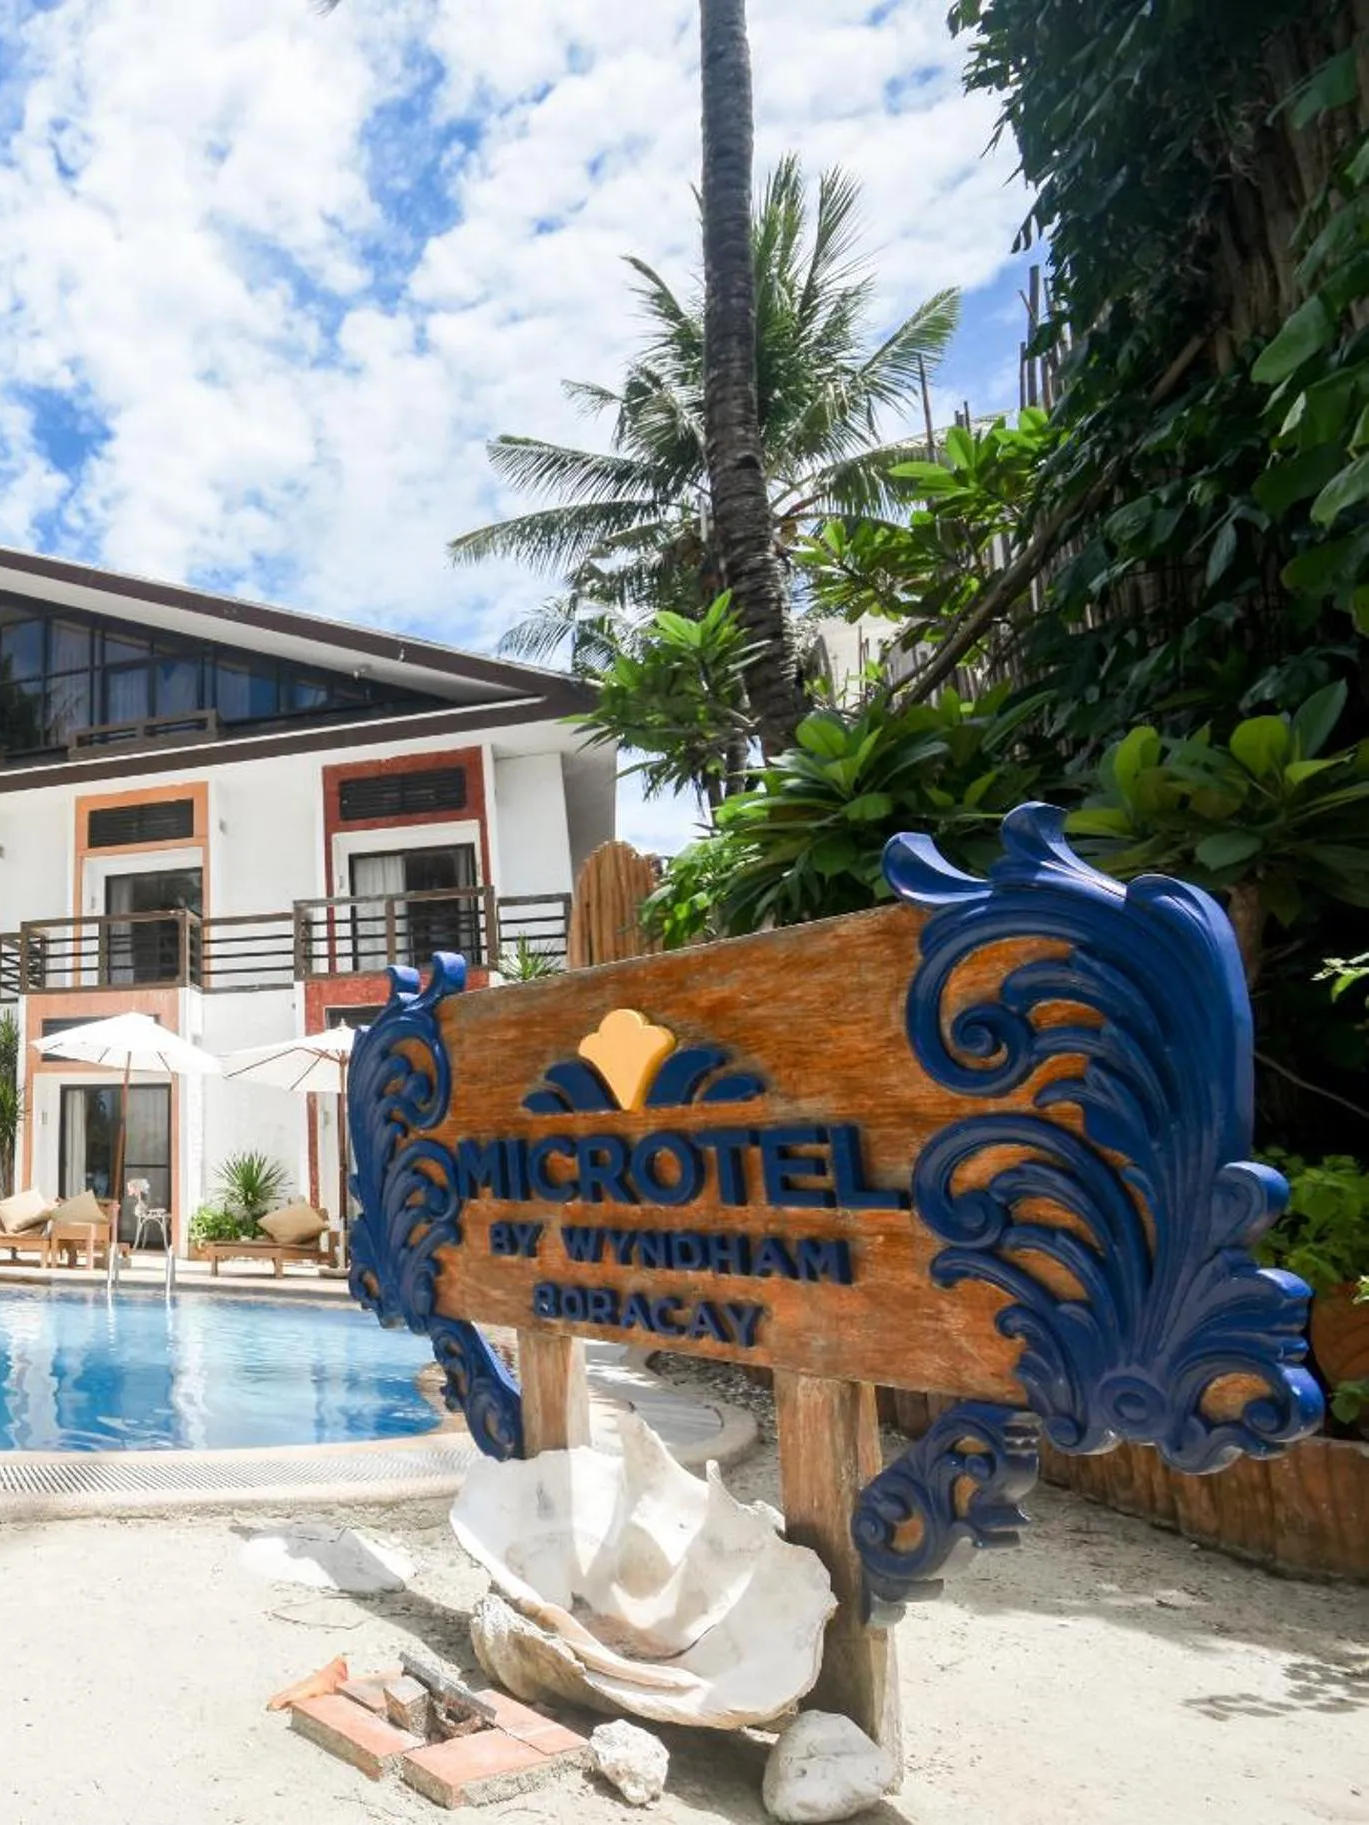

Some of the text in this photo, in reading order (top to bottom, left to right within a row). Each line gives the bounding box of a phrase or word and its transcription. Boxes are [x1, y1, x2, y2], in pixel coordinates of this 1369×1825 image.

[457, 1124, 911, 1209] MICROTEL
[489, 1220, 853, 1285] BY WYNDHAM
[533, 1281, 763, 1347] BORACAY
